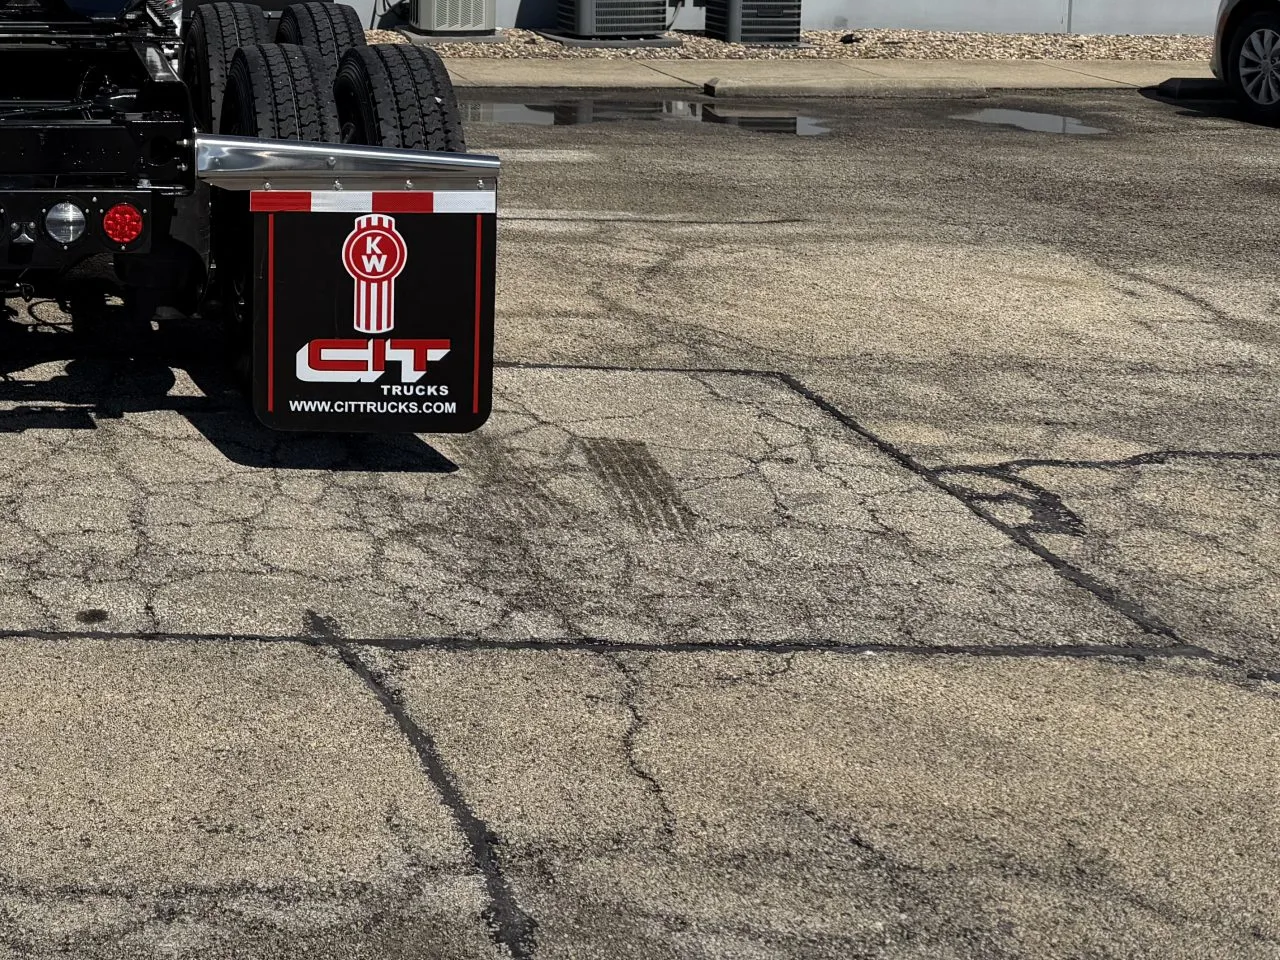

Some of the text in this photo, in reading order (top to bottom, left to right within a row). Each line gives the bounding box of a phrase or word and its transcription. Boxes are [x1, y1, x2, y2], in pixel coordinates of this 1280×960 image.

[366, 236, 382, 254] K
[361, 254, 387, 272] W
[296, 338, 451, 383] CIT
[380, 385, 449, 396] TRUCKS
[289, 400, 456, 414] WWW.CITTRUCKS.COM
